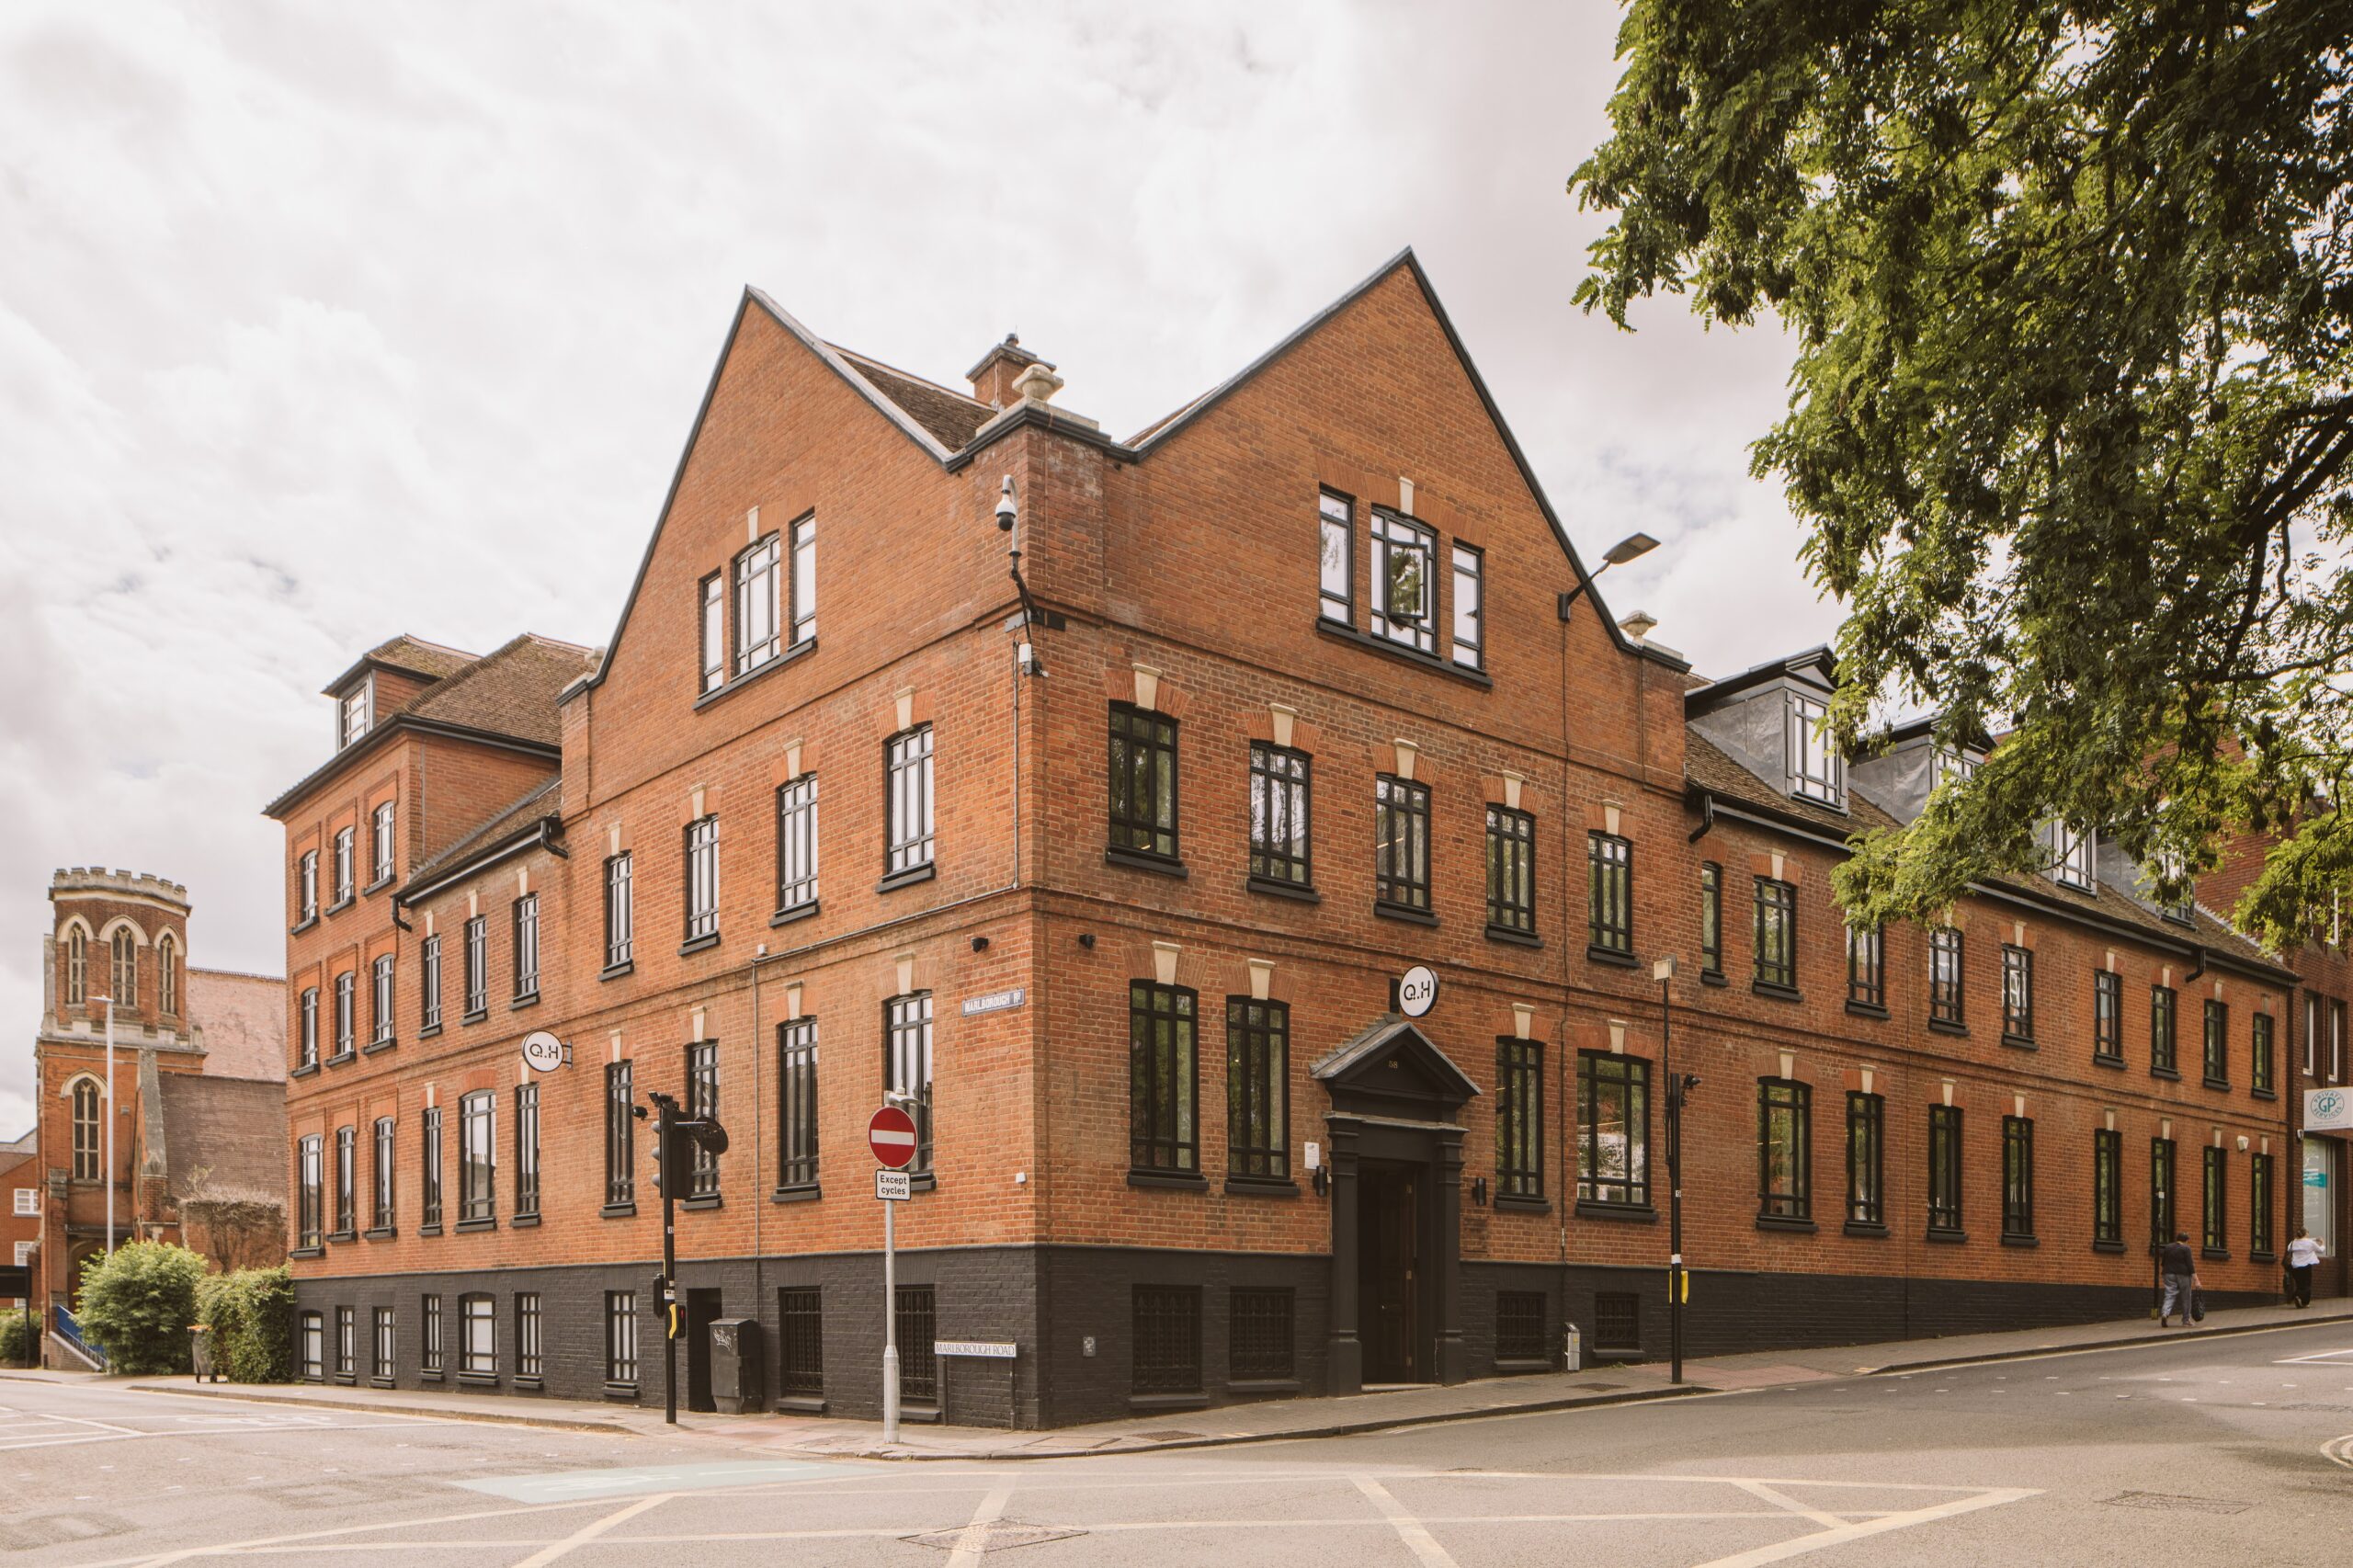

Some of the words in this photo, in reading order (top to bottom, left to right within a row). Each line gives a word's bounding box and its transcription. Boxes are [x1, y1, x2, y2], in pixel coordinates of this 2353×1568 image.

[964, 994, 1010, 1013] MARLBOROUGH
[2318, 1096, 2336, 1113] GP
[880, 1175, 907, 1186] Except
[881, 1186, 906, 1196] cycles
[936, 1343, 991, 1355] MARLBOROUGH
[993, 1345, 1015, 1356] ROAD
